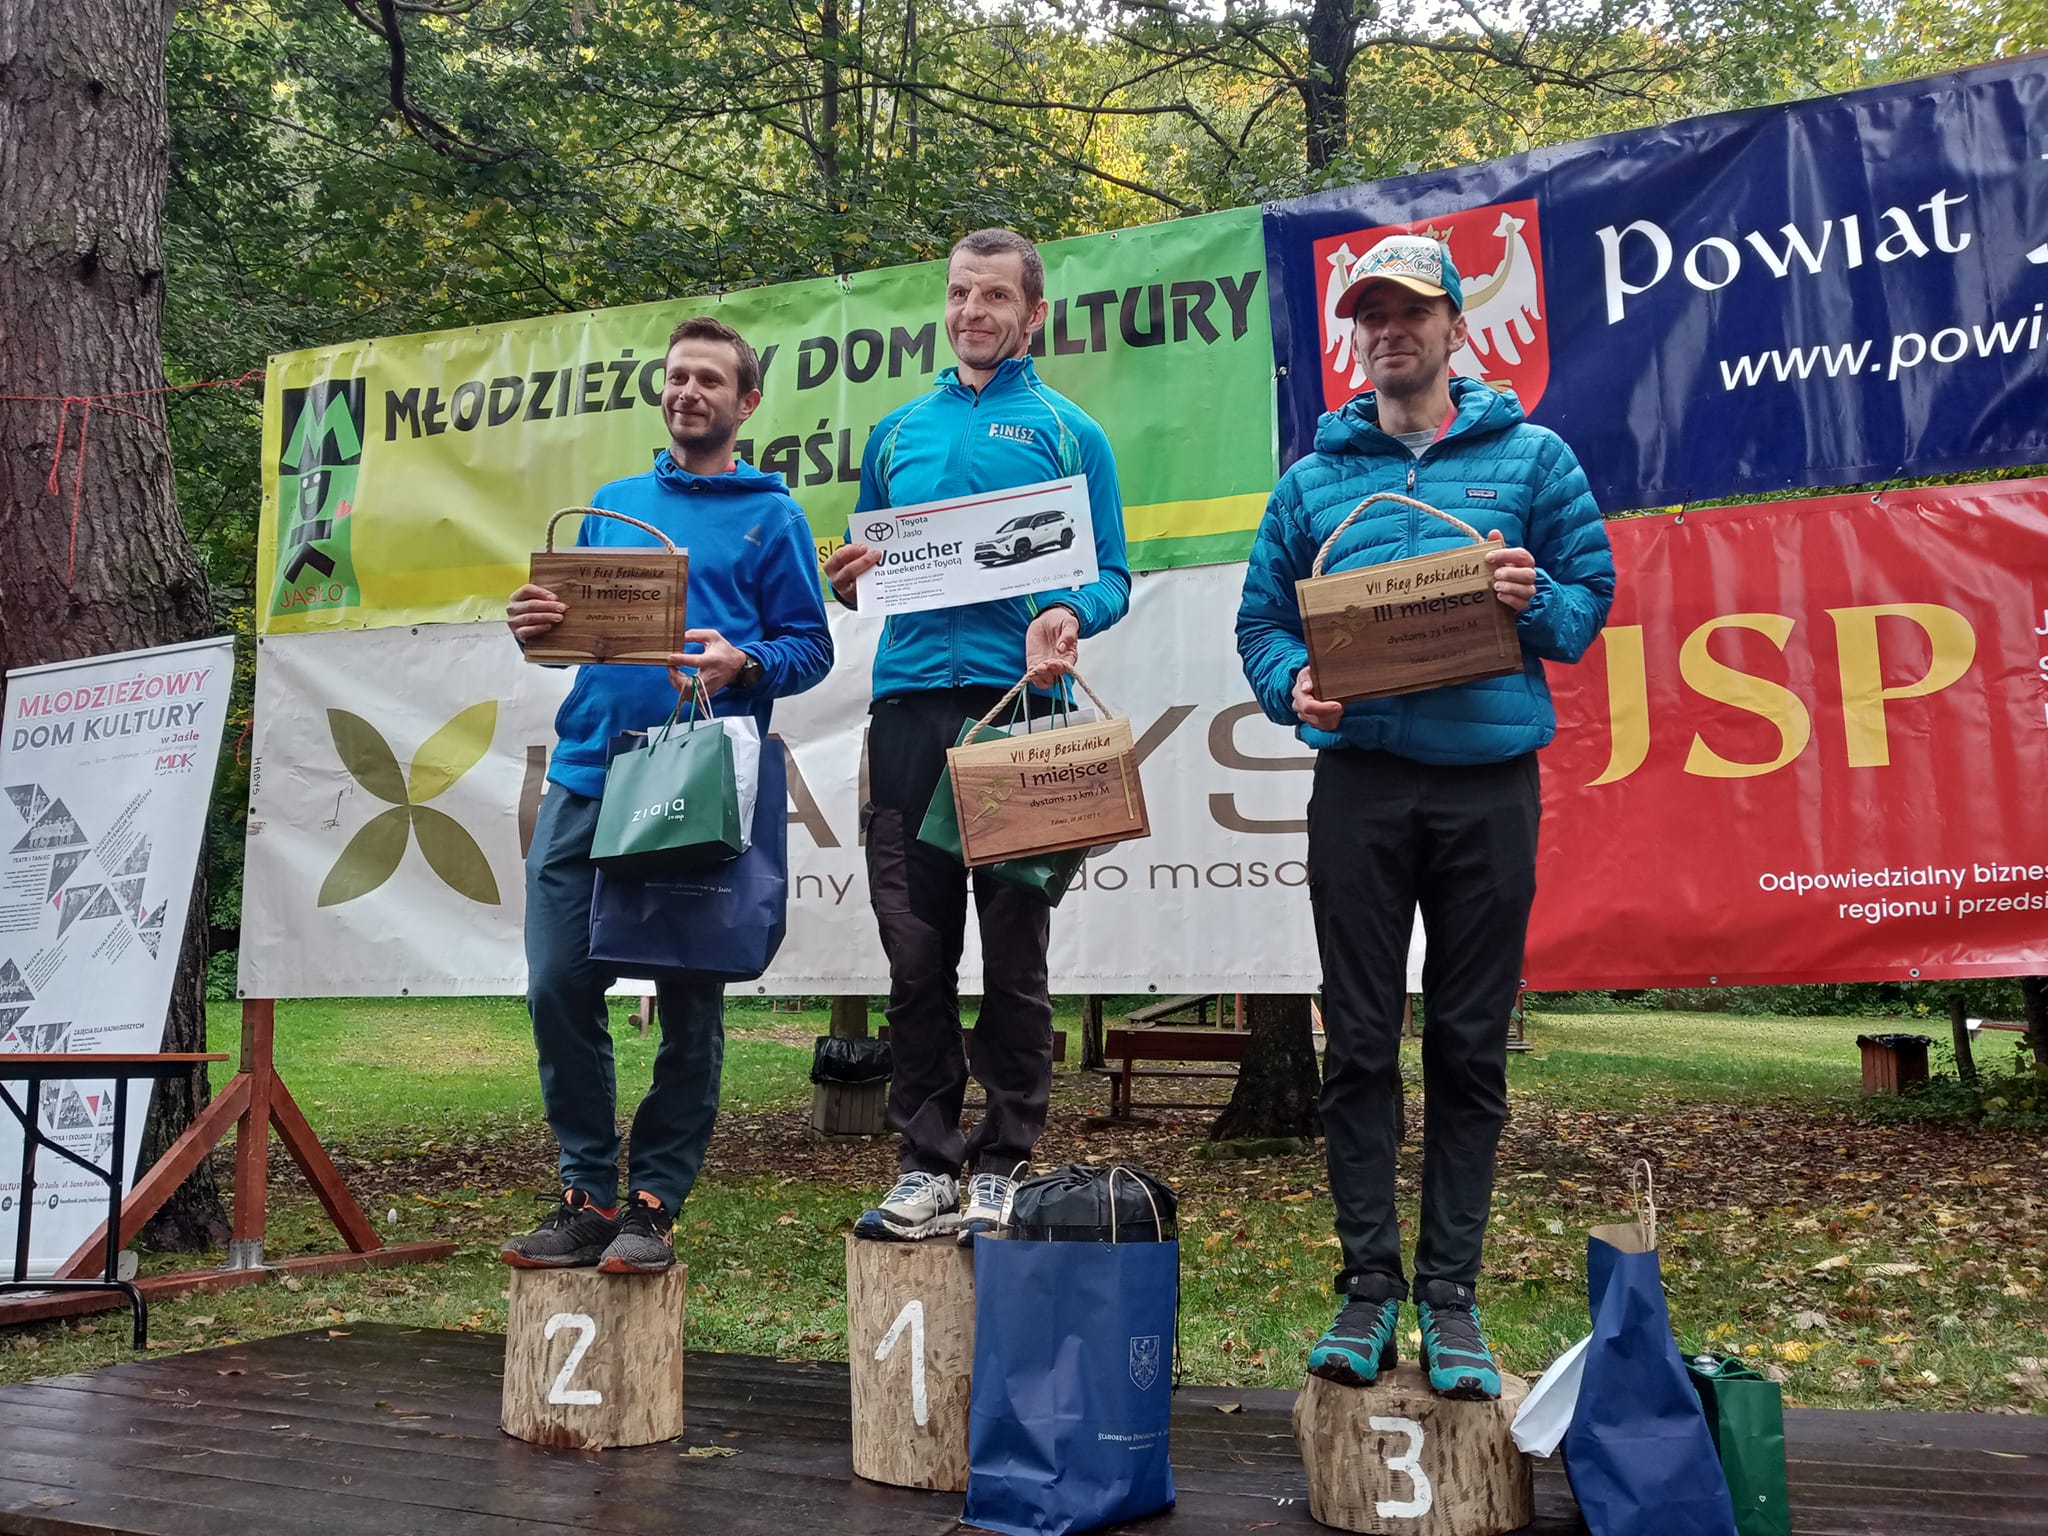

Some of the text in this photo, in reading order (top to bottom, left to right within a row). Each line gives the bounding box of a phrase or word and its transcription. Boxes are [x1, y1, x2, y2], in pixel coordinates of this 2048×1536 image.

[1595, 188, 1971, 325] Powiat
[385, 270, 1262, 441] MŁODZIEŻOY DOM LTURY
[901, 516, 928, 527] Toyota
[876, 541, 962, 567] Voucher
[887, 562, 925, 575] weekend
[1366, 564, 1479, 595] VII Bieg Beskidnika
[279, 584, 344, 609] JASŁO
[582, 584, 661, 604] II miejsce
[1373, 591, 1485, 623] III miejsce
[1387, 632, 1426, 645] dystans
[1442, 625, 1459, 633] km
[18, 669, 210, 718] MŁODZIEŻOWY
[1583, 602, 1977, 787] JSP
[12, 701, 204, 751] DOM KULTURY
[171, 730, 199, 742] Jaśle
[155, 753, 196, 770] MDK
[1011, 736, 1110, 763] VII Bieg Beskidnika
[1032, 762, 1109, 786] miejsce
[1030, 796, 1065, 808] dystans
[1079, 791, 1094, 799] km
[1100, 786, 1110, 795] M
[1150, 860, 1311, 888] masa
[1759, 865, 1966, 895] Odpowiedzialny
[1839, 898, 1937, 924] regionu
[1945, 896, 1950, 915] i
[544, 1313, 602, 1406] 2
[875, 1300, 929, 1426] 1
[1368, 1416, 1432, 1518] 3
